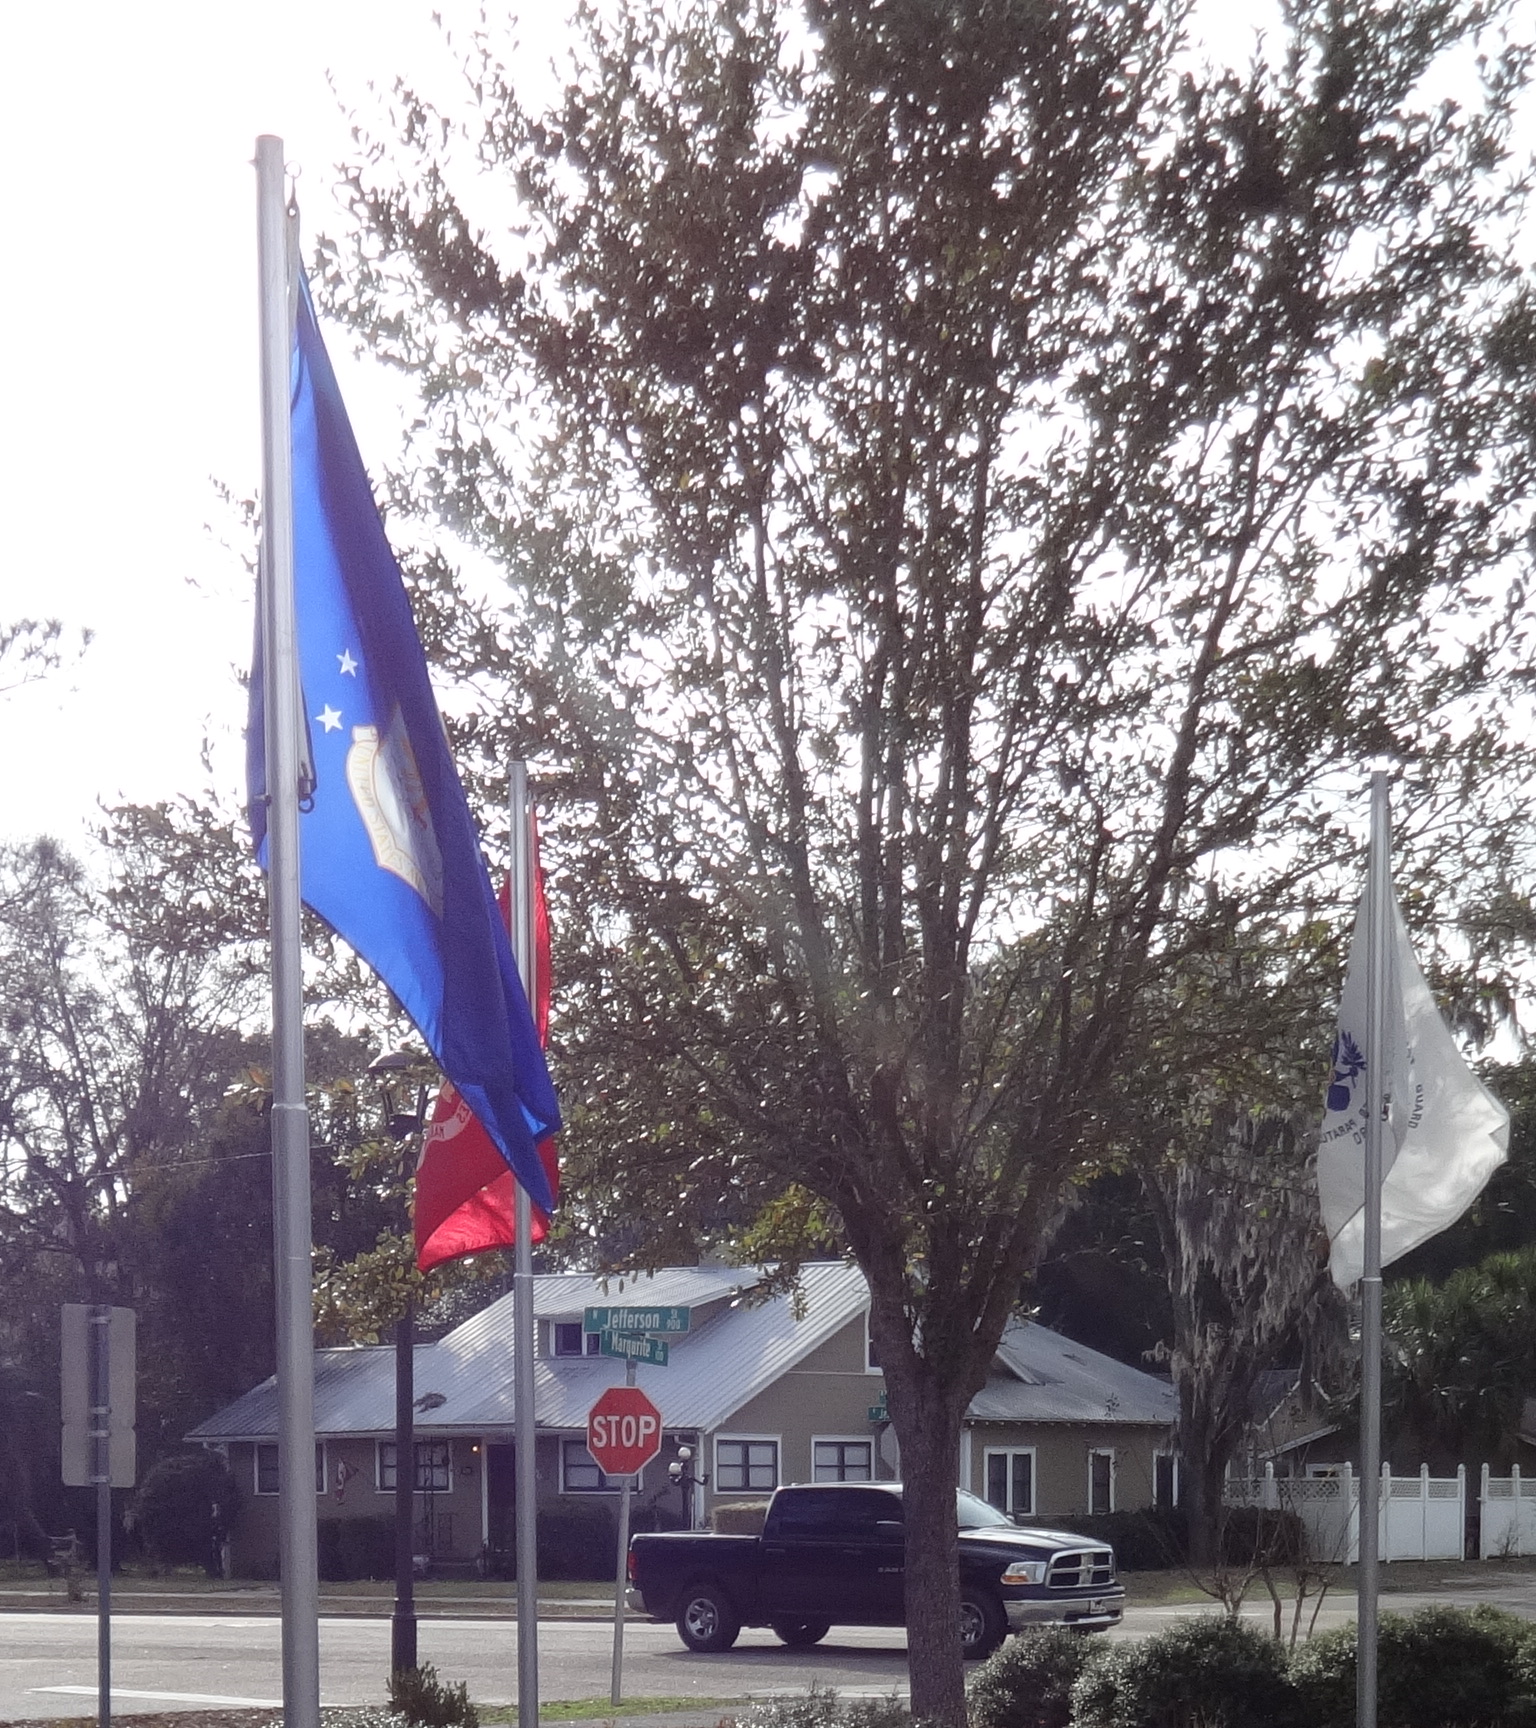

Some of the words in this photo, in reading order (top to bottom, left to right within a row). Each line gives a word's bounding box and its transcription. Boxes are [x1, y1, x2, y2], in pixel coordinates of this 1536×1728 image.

[1408, 1084, 1424, 1129] GUARD
[602, 1309, 660, 1329] Jefferson
[593, 1415, 657, 1448] STOP
